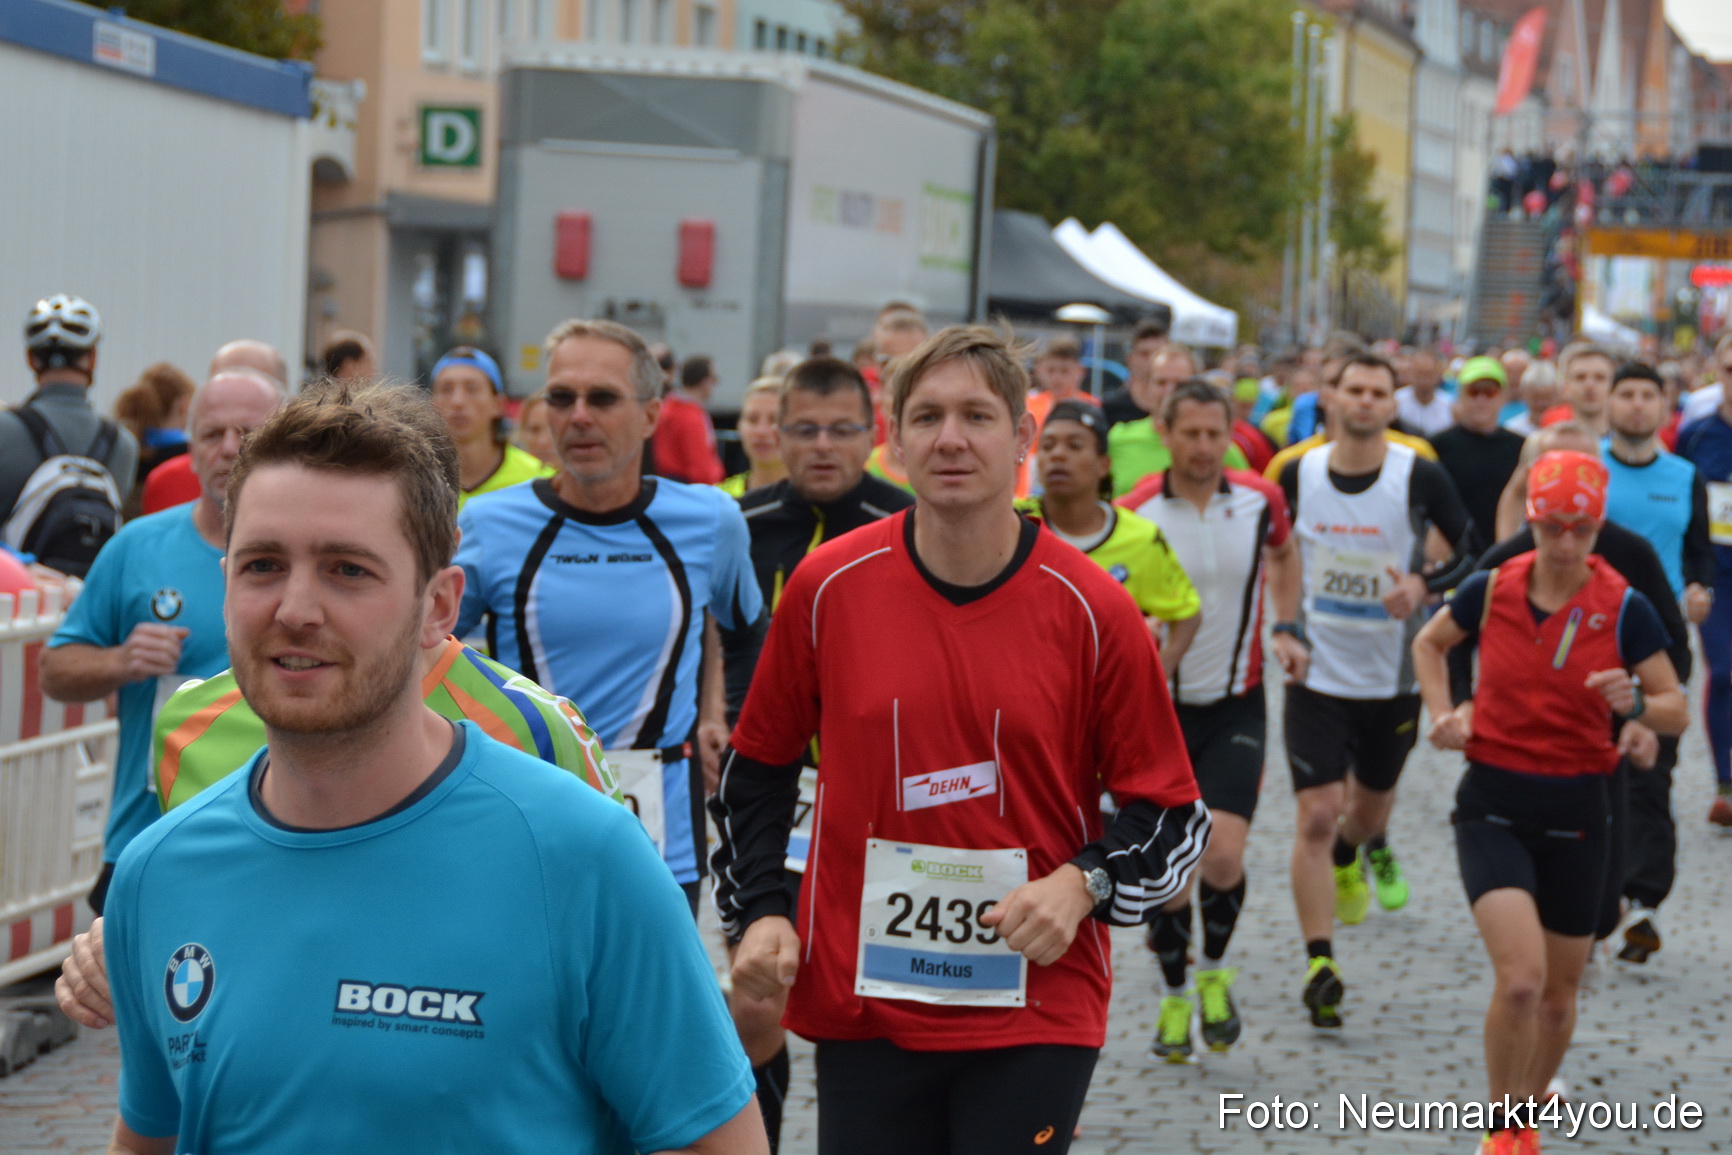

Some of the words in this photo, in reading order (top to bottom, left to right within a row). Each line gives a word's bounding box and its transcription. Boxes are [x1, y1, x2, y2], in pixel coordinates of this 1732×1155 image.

[427, 111, 475, 162] D
[1324, 569, 1379, 598] 2051
[929, 776, 971, 797] DEHN
[927, 862, 984, 879] BOCK
[886, 892, 1001, 945] 2439
[168, 945, 212, 973] BMW
[910, 957, 973, 978] Markus
[337, 982, 478, 1023] BOCK
[331, 1015, 375, 1028] inspired
[377, 1019, 391, 1031] by
[394, 1023, 429, 1034] smart
[431, 1026, 486, 1040] concepts
